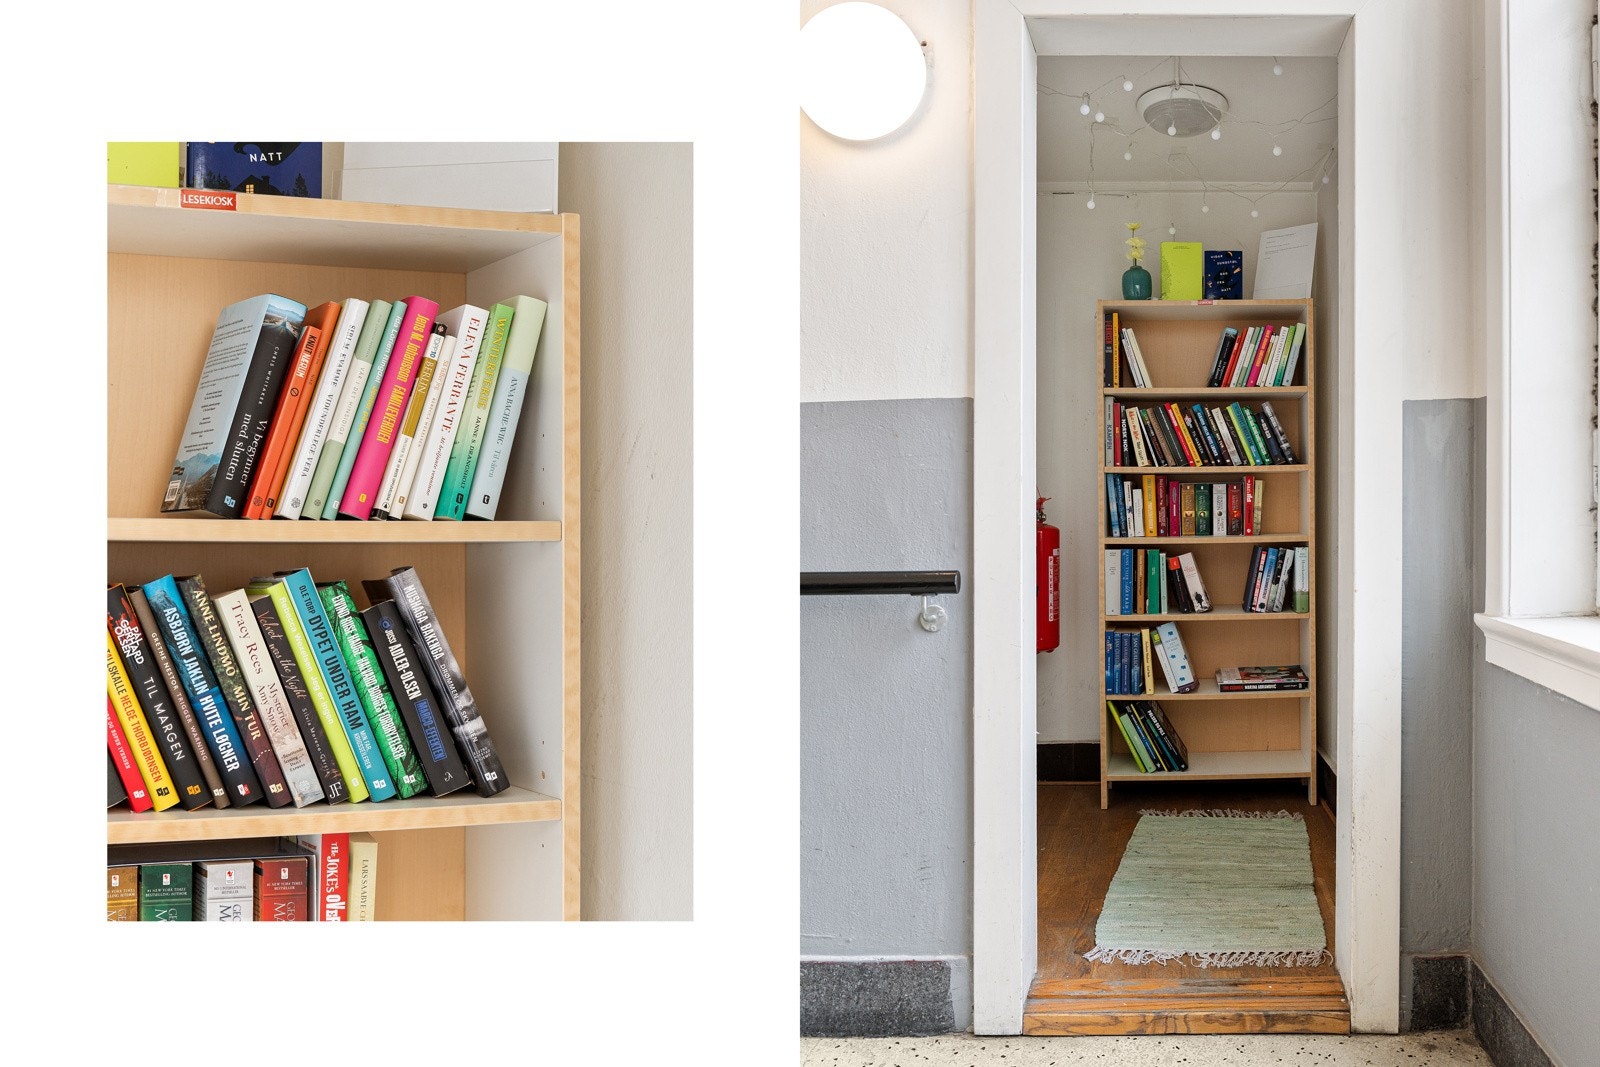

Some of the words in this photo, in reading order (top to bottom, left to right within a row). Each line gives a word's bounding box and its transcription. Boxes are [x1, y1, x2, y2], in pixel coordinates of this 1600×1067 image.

[250, 152, 282, 162] NATT
[183, 194, 234, 206] LESEKIOSK
[347, 325, 355, 341] SIRI
[394, 316, 402, 328] Ida
[410, 332, 424, 342] M.
[413, 314, 430, 332] Jens
[461, 317, 480, 359] ELENA
[270, 346, 280, 367] CHRIS
[304, 334, 316, 354] KNUT
[397, 341, 420, 382] Johansson
[477, 318, 506, 410] WINTERFERIE
[296, 352, 311, 378] NÆRUM
[334, 353, 347, 387] KVAMME
[375, 353, 389, 384] Ringdal
[418, 361, 434, 394] BERLIN
[259, 370, 272, 404] WHITAKER
[442, 364, 468, 433] FERRANTE
[506, 376, 517, 398] ANNA
[239, 414, 252, 439] med
[257, 420, 268, 430] Vi
[309, 394, 333, 457] VIDUNDERLEGE
[377, 387, 406, 444] FAMILIEVERDIER
[497, 399, 513, 445] BACHE-WIIG
[226, 440, 244, 480] slutten
[240, 433, 263, 486] begynner
[301, 457, 313, 477] VERA
[434, 444, 444, 469] briljante
[461, 446, 474, 489] DRANGSHOLT
[280, 597, 296, 632] Rebecca
[299, 585, 308, 600] OLE
[304, 600, 316, 614] TORP
[120, 619, 144, 664] GERHARD
[194, 590, 214, 624] ANNE
[209, 625, 236, 676] LINDMO
[232, 600, 250, 639] Tracy
[246, 642, 263, 674] Rees
[258, 610, 283, 641] Velvet
[332, 594, 345, 618] EIVIND
[347, 634, 365, 658] HAUGE
[404, 584, 429, 624] MUSHAGA
[421, 622, 445, 660] BAKENGA
[115, 627, 132, 658] OLSEN
[151, 632, 166, 660] GRETHE
[164, 662, 178, 690] NESTOR
[163, 607, 194, 656] ASBJØRN
[184, 657, 209, 695] JAKLIN
[269, 643, 282, 659] was
[280, 659, 296, 674] the
[309, 615, 334, 654] DYPET
[325, 656, 350, 699] UNDER
[342, 700, 364, 730] HAM
[388, 644, 422, 700] ADLER-OLSEN
[440, 664, 459, 699] DRØMMEN
[268, 682, 289, 727] Mysteriet
[281, 674, 307, 700] Night
[144, 676, 158, 698] TIL
[154, 702, 185, 761] MARGEN
[177, 693, 192, 723] TRIGGER
[191, 726, 208, 761] WARNING
[233, 686, 250, 712] MIN
[245, 713, 261, 740] TUR
[257, 684, 268, 705] Amy
[266, 705, 280, 734] Snow
[302, 708, 311, 726] Silvia
[356, 656, 378, 687] HALVARD
[379, 711, 406, 760] FORBRYTELSER
[121, 695, 138, 720] HELGE
[131, 720, 162, 782] THORBJØRNSEN
[200, 695, 222, 728] HVITE
[212, 728, 240, 772] LØGNER
[416, 700, 446, 761] MARCO-EFFEKTEN
